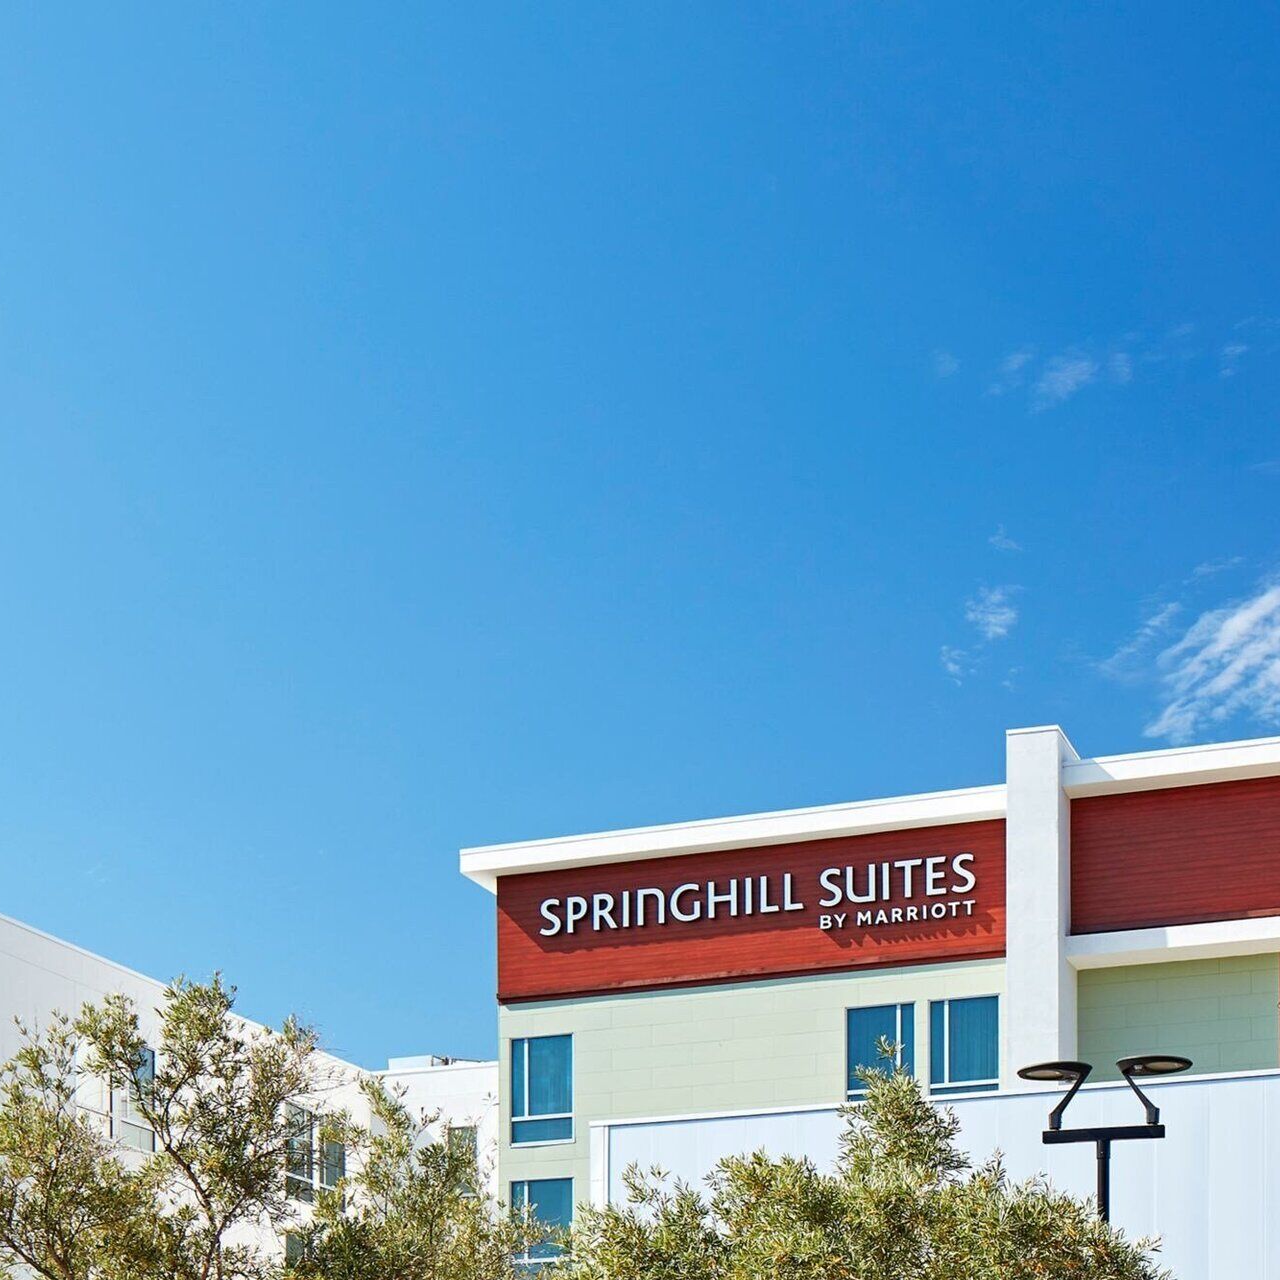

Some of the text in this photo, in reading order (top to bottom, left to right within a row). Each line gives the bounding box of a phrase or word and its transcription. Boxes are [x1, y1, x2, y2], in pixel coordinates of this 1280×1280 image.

[539, 853, 976, 936] SPRINGHILL SUITES
[819, 899, 976, 930] BY MARRIOTT
